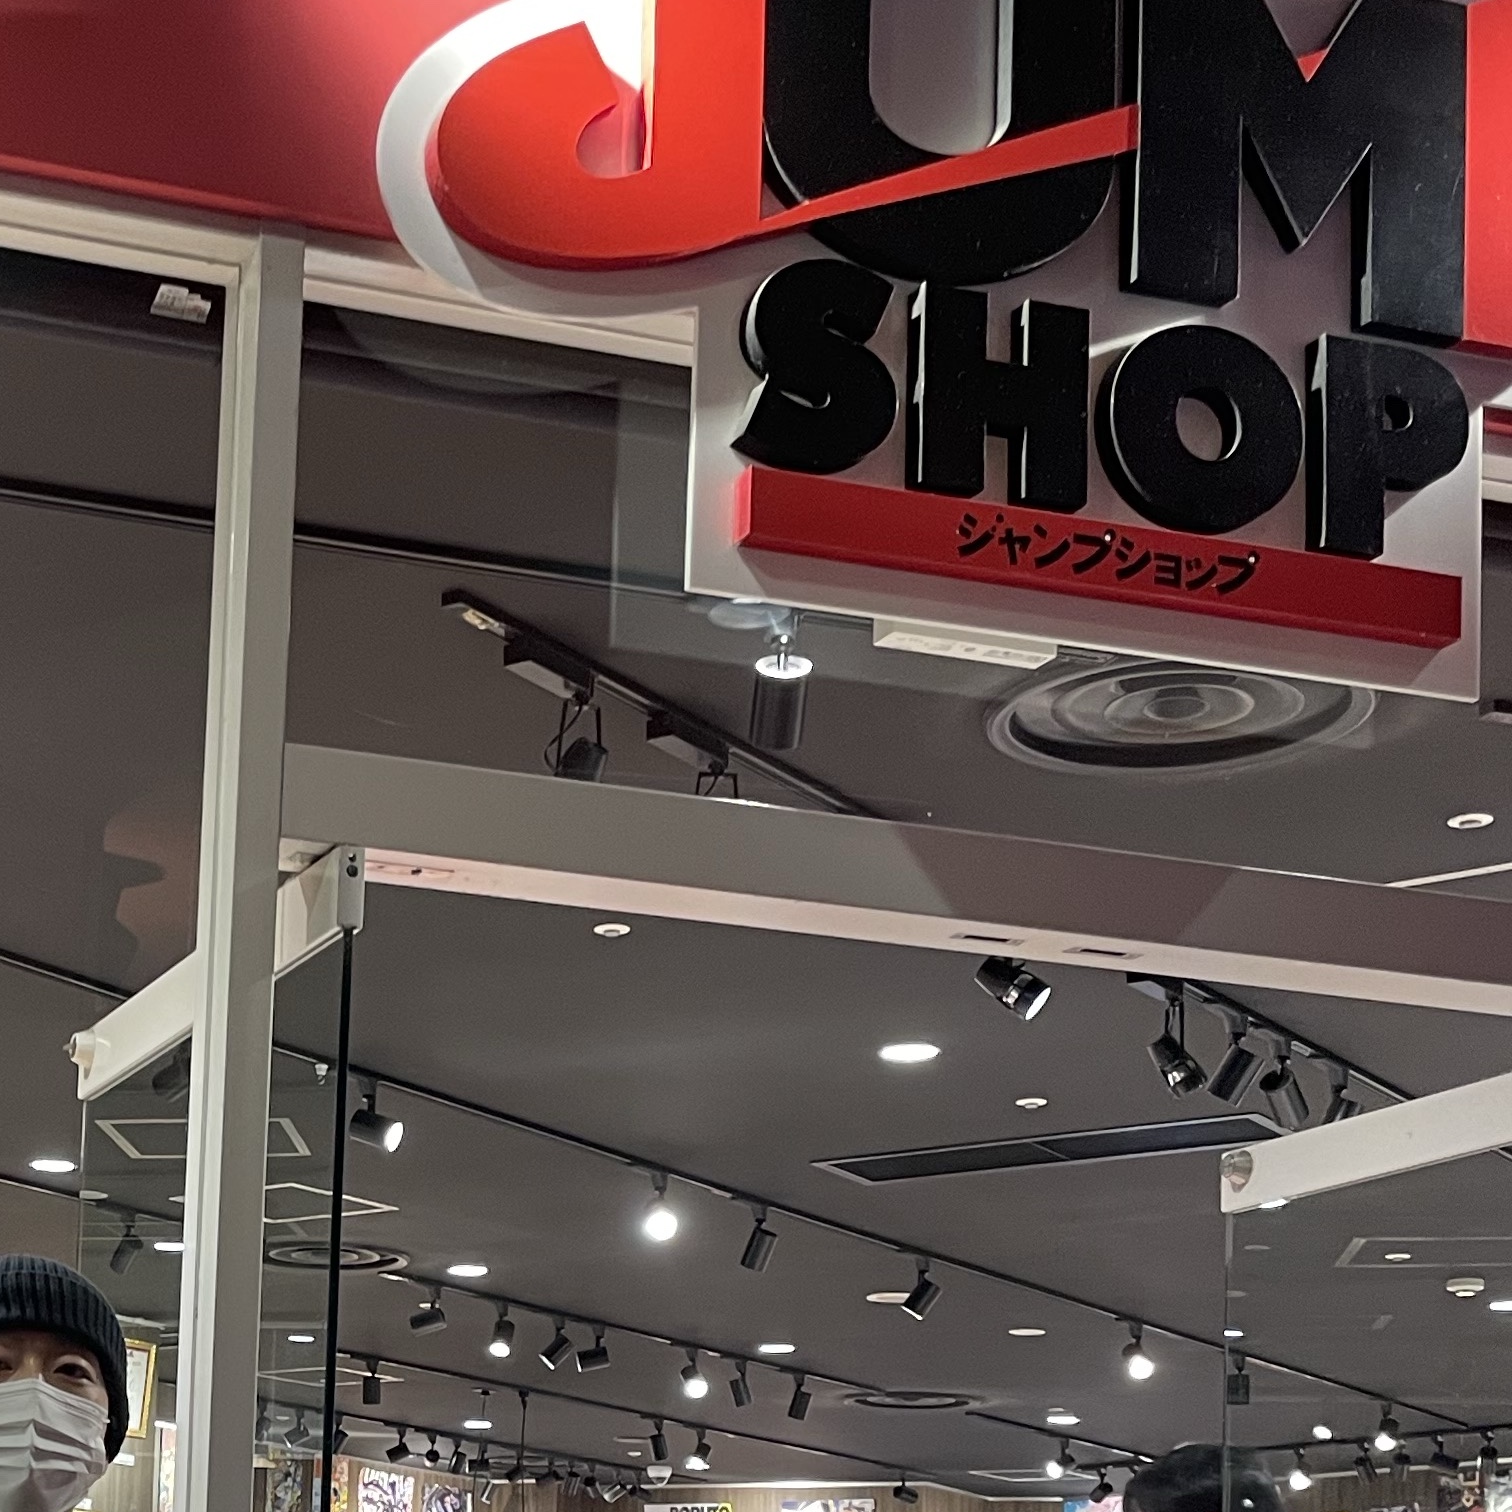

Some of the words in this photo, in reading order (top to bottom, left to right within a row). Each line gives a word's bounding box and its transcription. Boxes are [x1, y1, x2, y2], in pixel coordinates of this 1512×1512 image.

[731, 258, 1470, 559] SHOP
[956, 512, 1261, 595] ジャンプショップ
